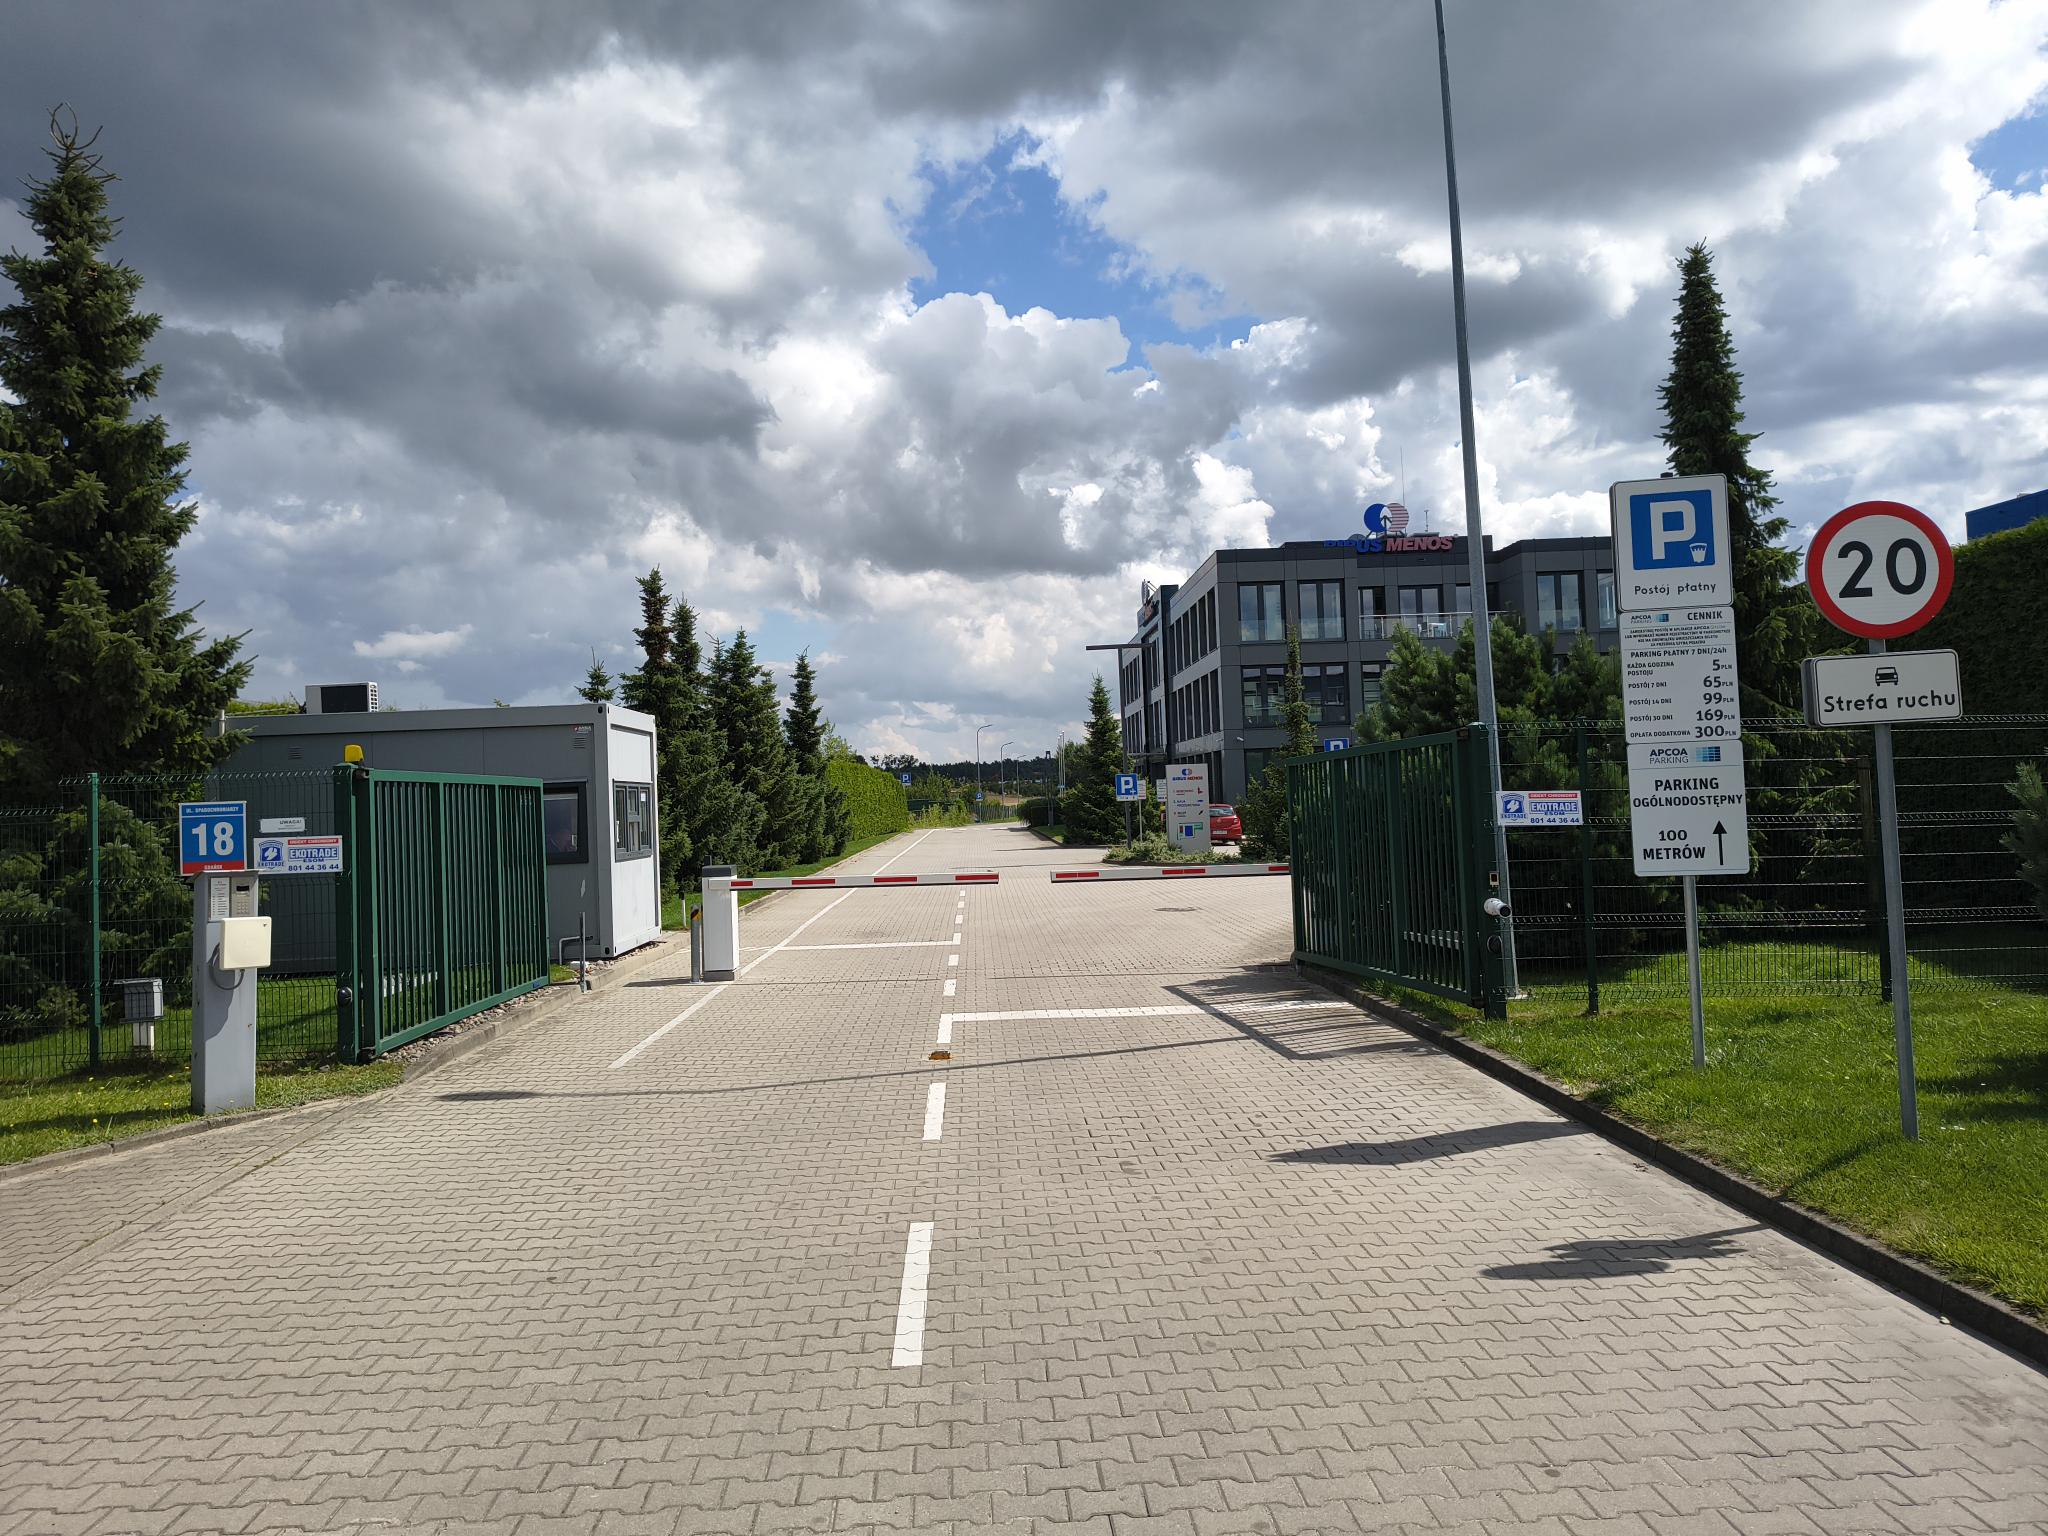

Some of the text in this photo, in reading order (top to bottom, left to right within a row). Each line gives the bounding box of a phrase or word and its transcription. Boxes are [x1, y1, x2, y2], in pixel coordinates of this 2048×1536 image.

[1650, 500, 1696, 560] P
[1386, 536, 1453, 552] MENOS
[1837, 538, 1927, 599] 20
[1634, 582, 1717, 596] Postój płatny
[1687, 611, 1722, 620] CENNIK
[1631, 650, 1662, 658] PARKING
[1664, 648, 1689, 657] PŁATNY
[1698, 647, 1727, 655] DNI/24h
[1712, 659, 1721, 671] 5
[1703, 676, 1721, 688] 65
[1703, 692, 1722, 704] 99
[1824, 690, 1956, 713] Strefa ruchu
[1696, 709, 1723, 721] 169
[1694, 725, 1724, 738] 300
[1650, 748, 1688, 756] APCOA
[1650, 756, 1689, 764] PARKING
[1121, 777, 1134, 793] P
[1654, 778, 1719, 791] PARKING
[1531, 802, 1577, 811] EKOTRADE
[1633, 794, 1742, 808] OGÓLNODOSTĘPNY
[192, 822, 234, 856] 18
[1658, 830, 1688, 841] 100
[290, 849, 337, 858] EKOTRADE
[1643, 844, 1706, 860] METRÓW
